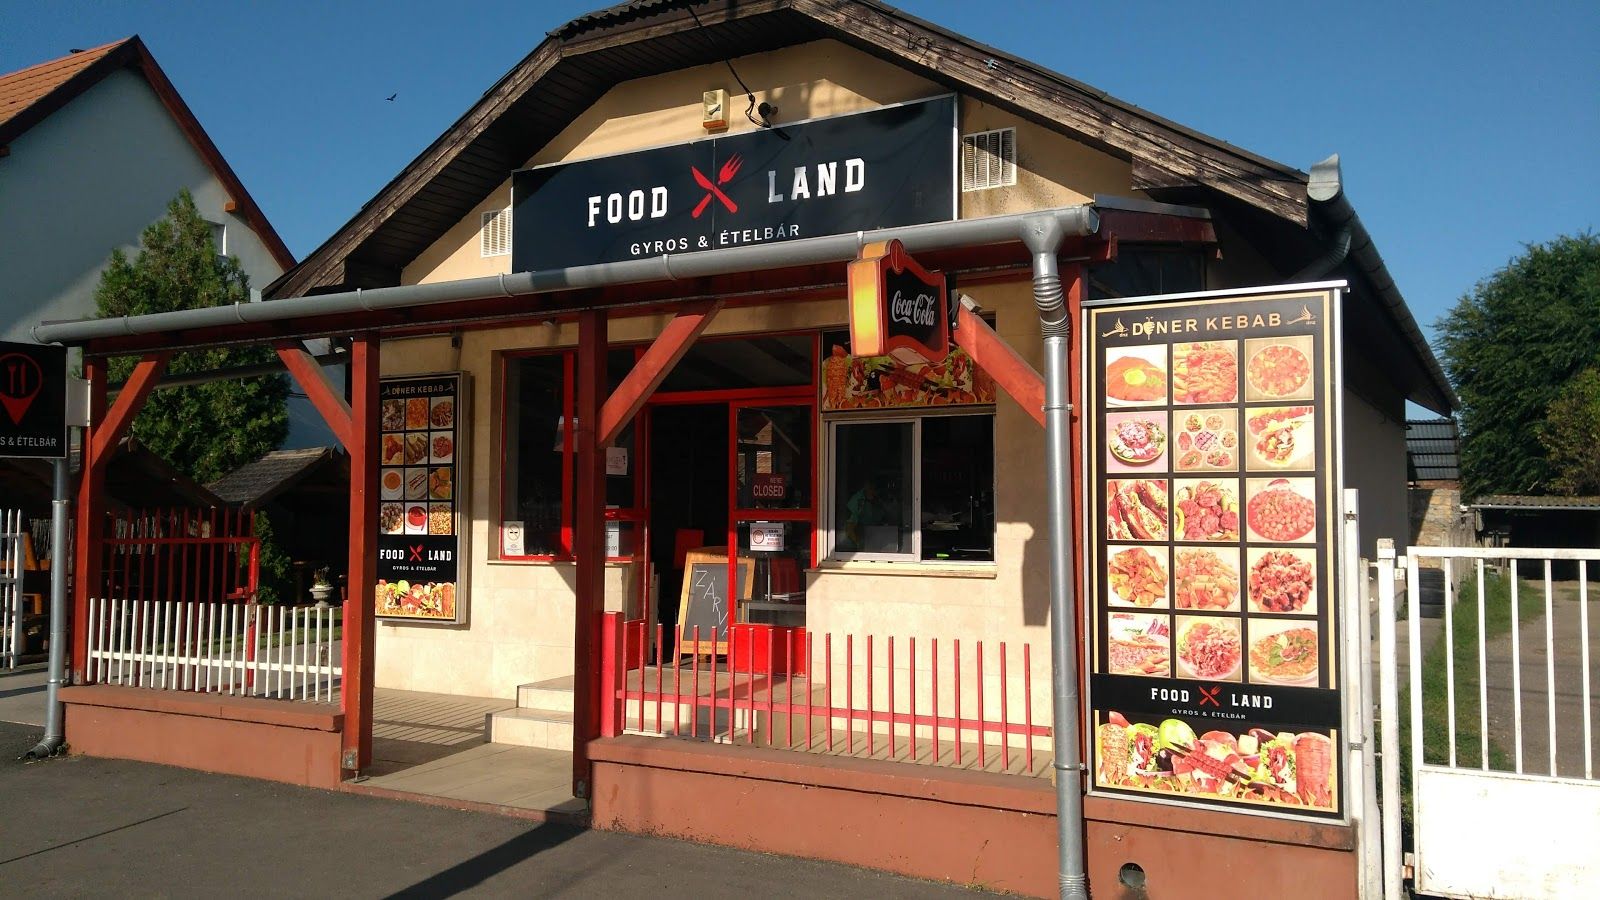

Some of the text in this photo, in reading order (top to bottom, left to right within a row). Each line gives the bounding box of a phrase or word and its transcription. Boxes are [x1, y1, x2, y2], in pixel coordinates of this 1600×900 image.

[588, 157, 865, 227] FOOD LAND
[630, 224, 800, 255] GYROS & ÉTELBÁR
[1206, 312, 1282, 331] KEBAB
[417, 384, 444, 394] KEBAB
[8, 436, 15, 446] &
[17, 434, 57, 447] ÉTELBÁR
[753, 484, 784, 497] CLOSED
[379, 549, 452, 561] FOOD LAND
[1151, 687, 1273, 709] FOOD LAND
[1171, 708, 1199, 716] GYROS
